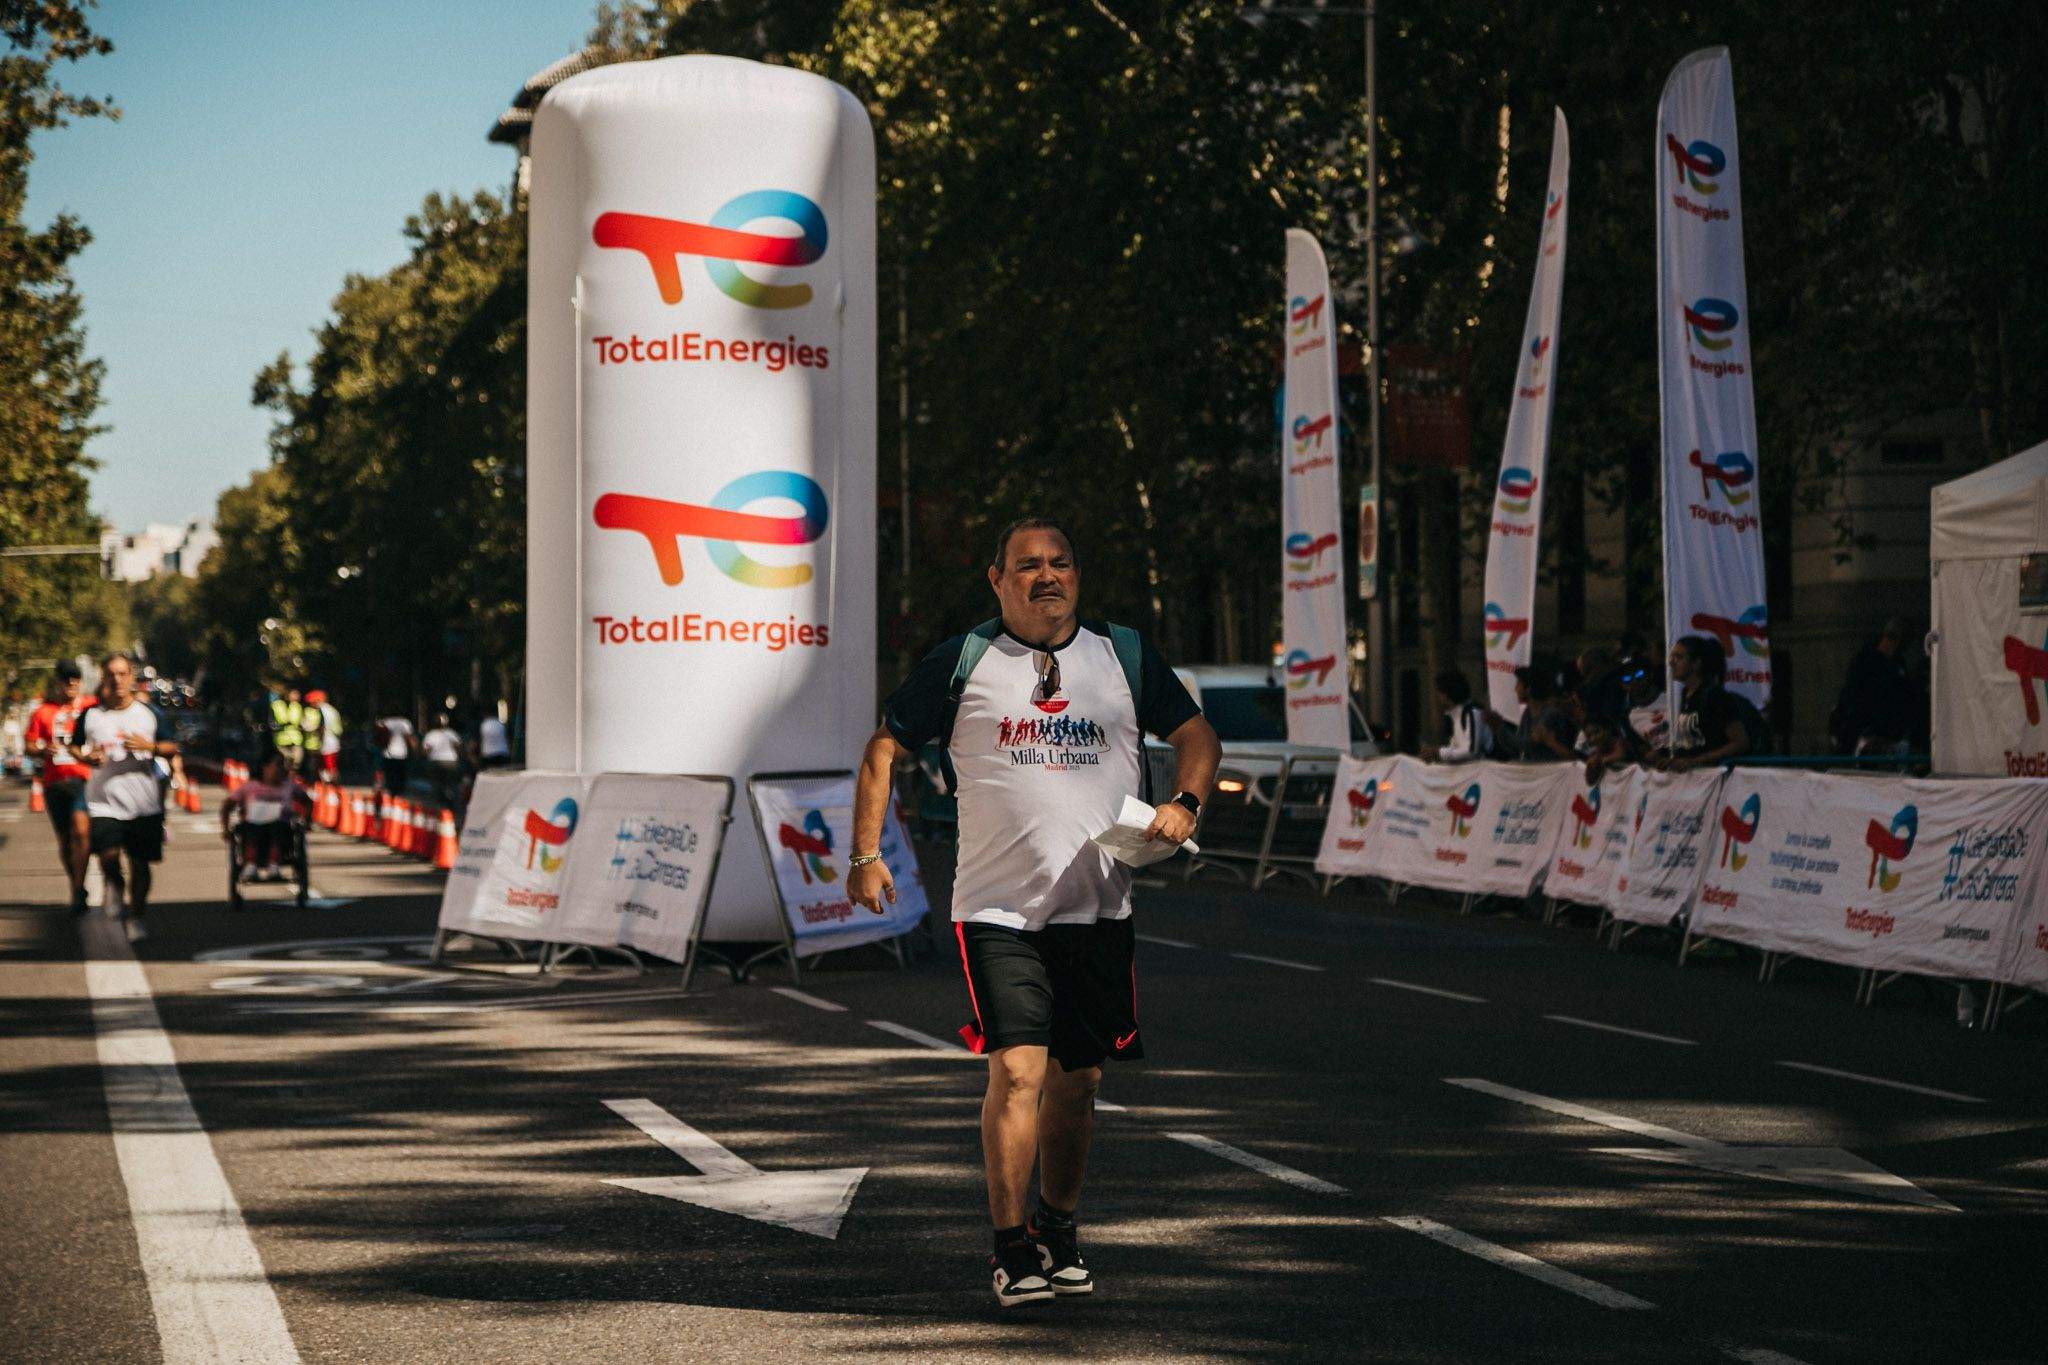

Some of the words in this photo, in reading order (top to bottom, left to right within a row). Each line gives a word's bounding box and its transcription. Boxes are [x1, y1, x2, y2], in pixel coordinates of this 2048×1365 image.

[592, 333, 830, 372] TotalEnergies
[592, 614, 830, 653] TotalEnergies
[1011, 748, 1045, 765] Milla
[1048, 748, 1100, 765] Urbana
[2004, 750, 2048, 777] TotalE
